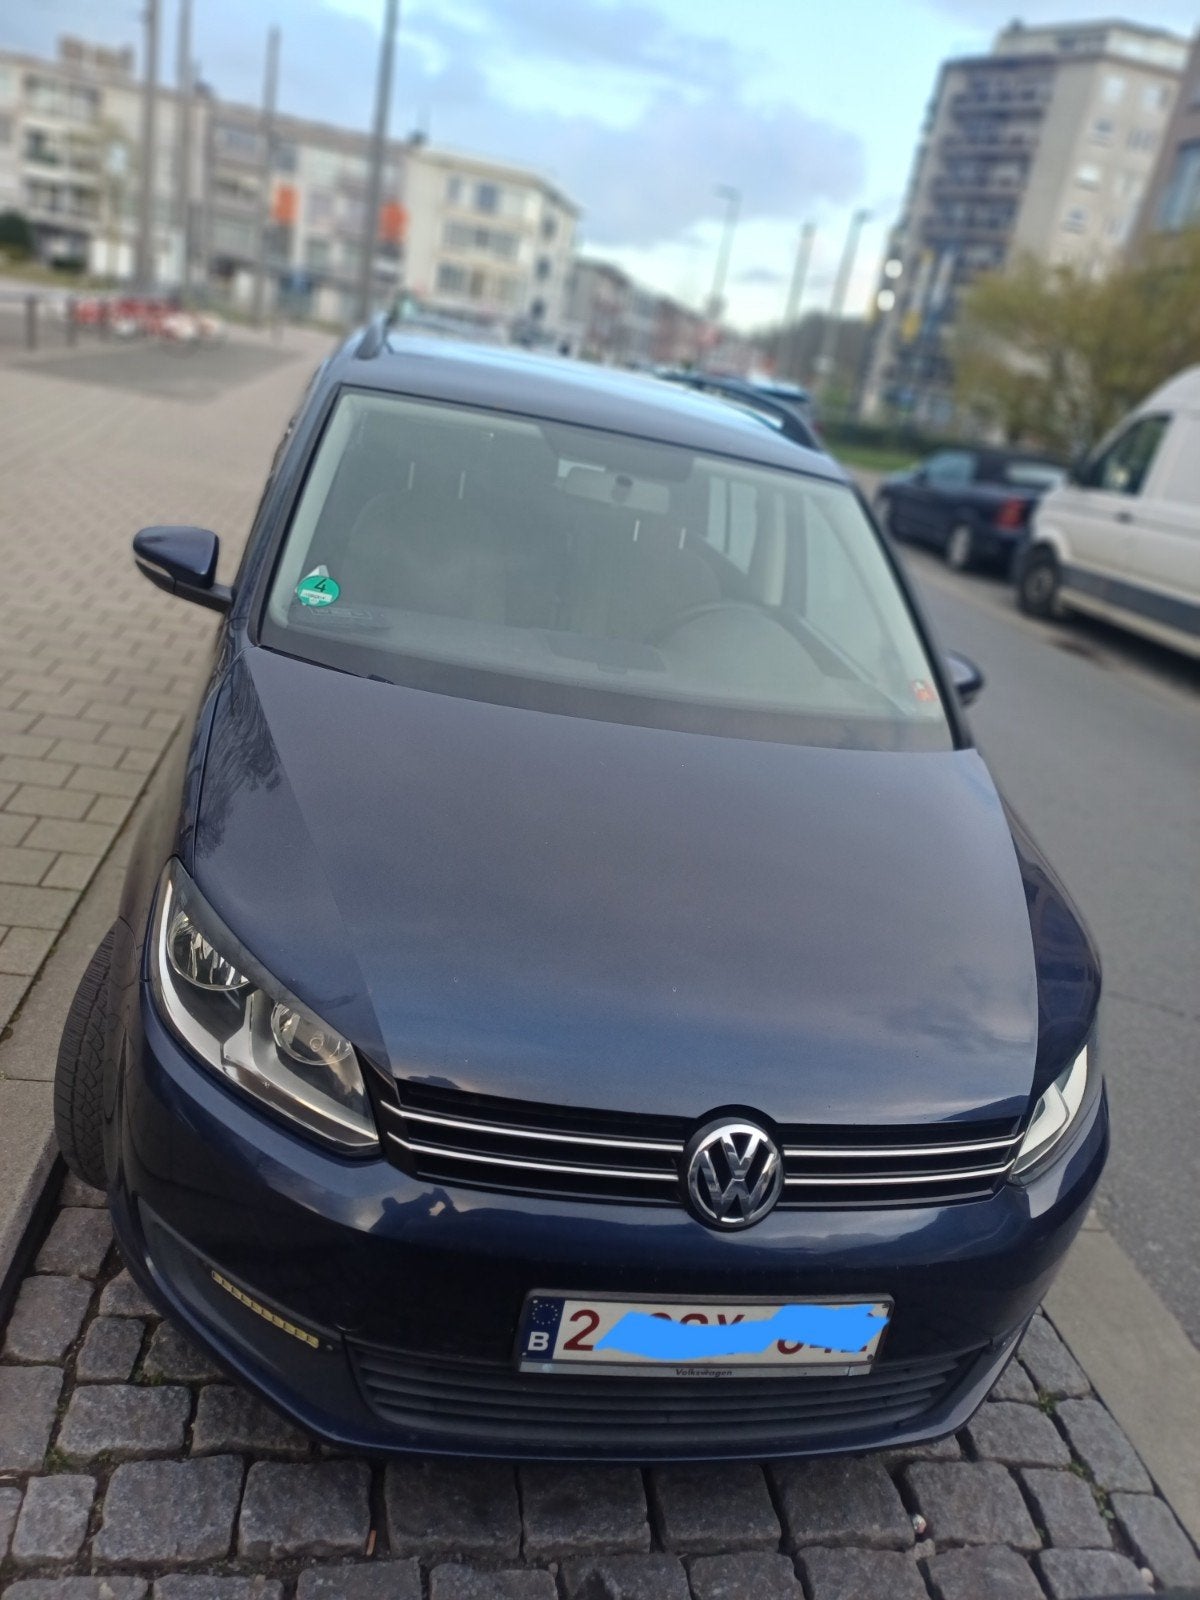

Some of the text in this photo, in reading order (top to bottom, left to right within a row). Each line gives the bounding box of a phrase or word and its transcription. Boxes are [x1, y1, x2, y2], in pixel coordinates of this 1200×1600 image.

[314, 578, 327, 593] 4
[527, 1331, 550, 1351] B
[675, 1368, 733, 1378] Volkswagen
